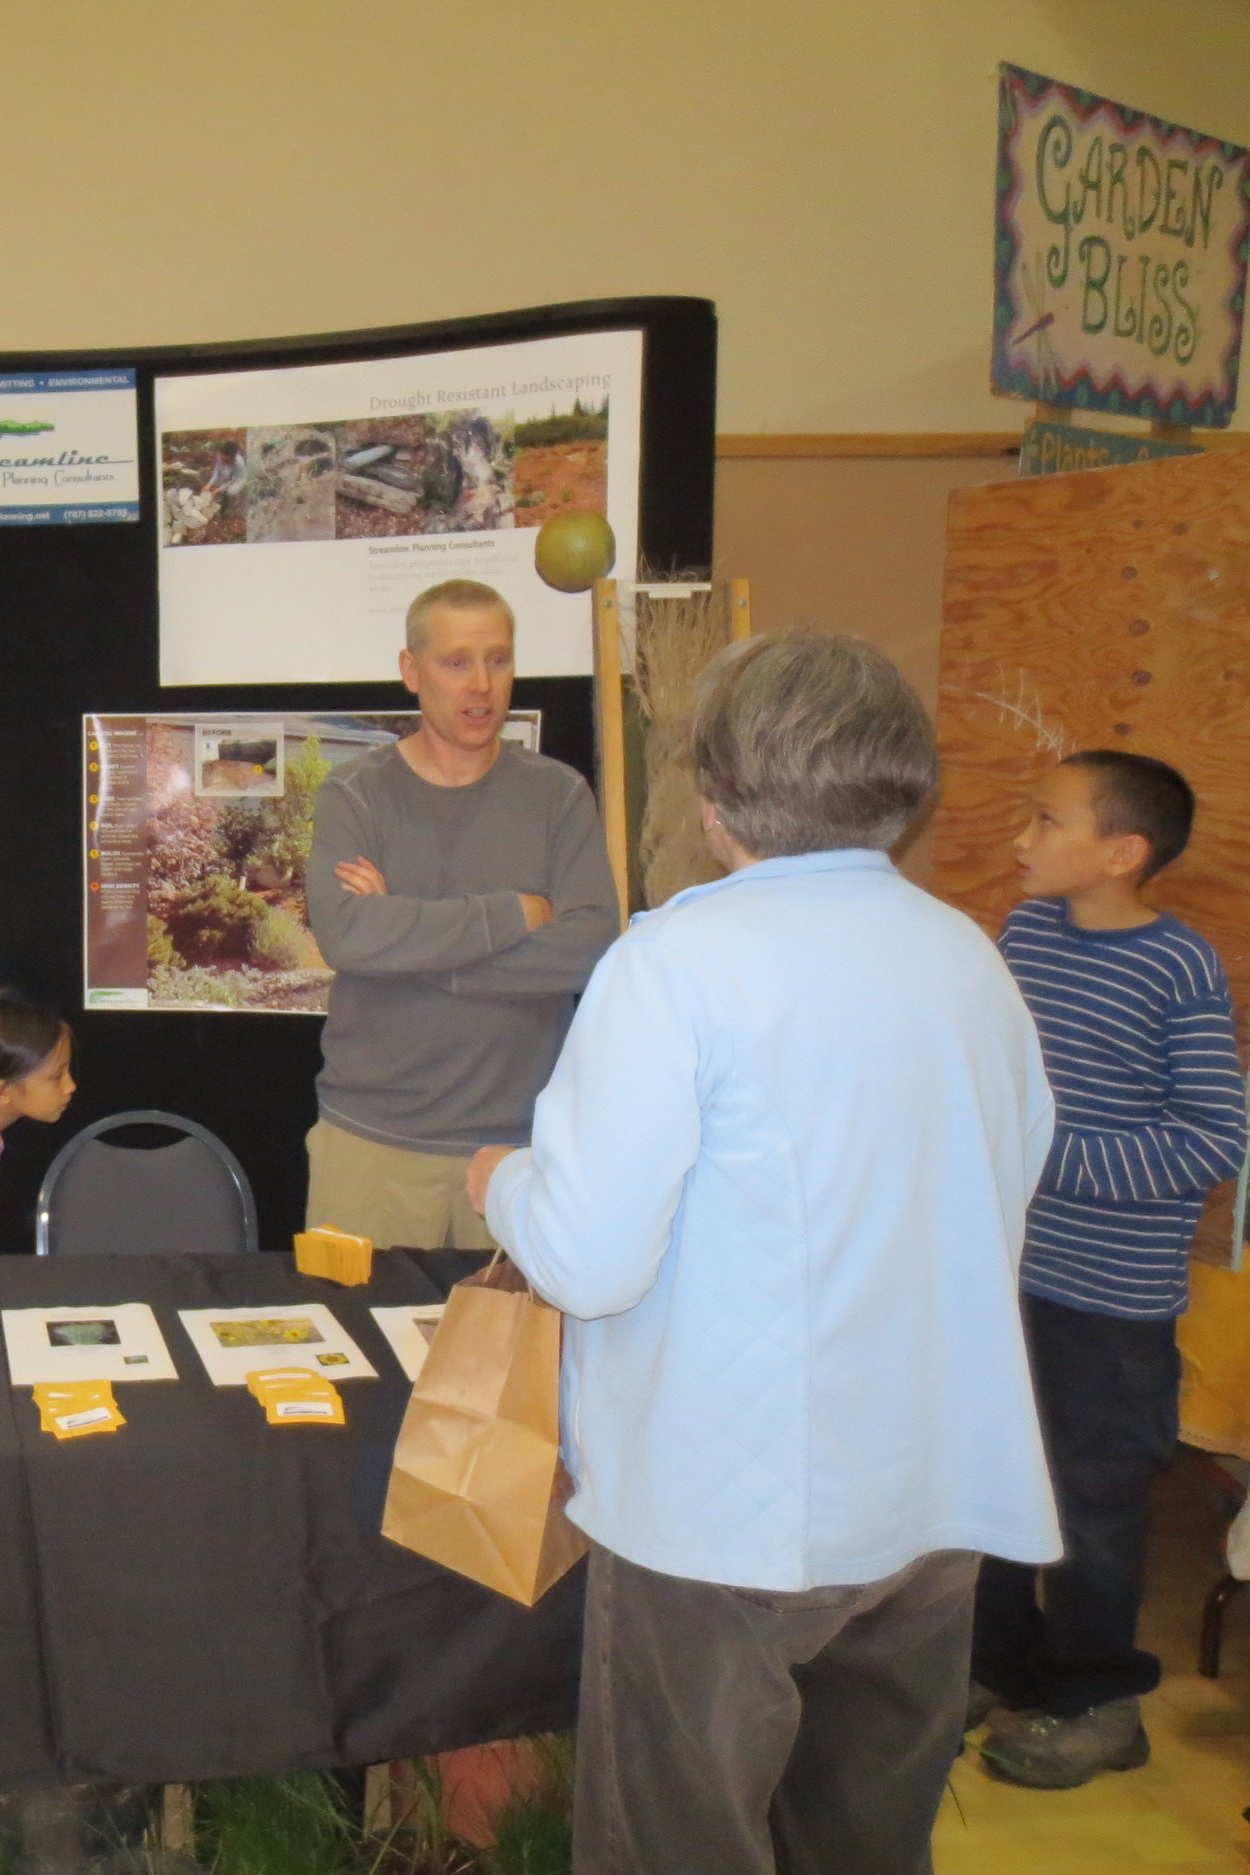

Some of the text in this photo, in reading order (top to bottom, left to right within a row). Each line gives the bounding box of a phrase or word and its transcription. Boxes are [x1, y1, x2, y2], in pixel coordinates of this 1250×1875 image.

[1036, 115, 1223, 287] GARDEN
[1079, 236, 1200, 366] BLISS
[48, 376, 130, 387] ENVIRONMENTAL
[370, 373, 612, 410] Drought Resistant Landscaping
[2, 469, 115, 487] Planning Consultants
[368, 540, 495, 555] Streamline Planning Consultants
